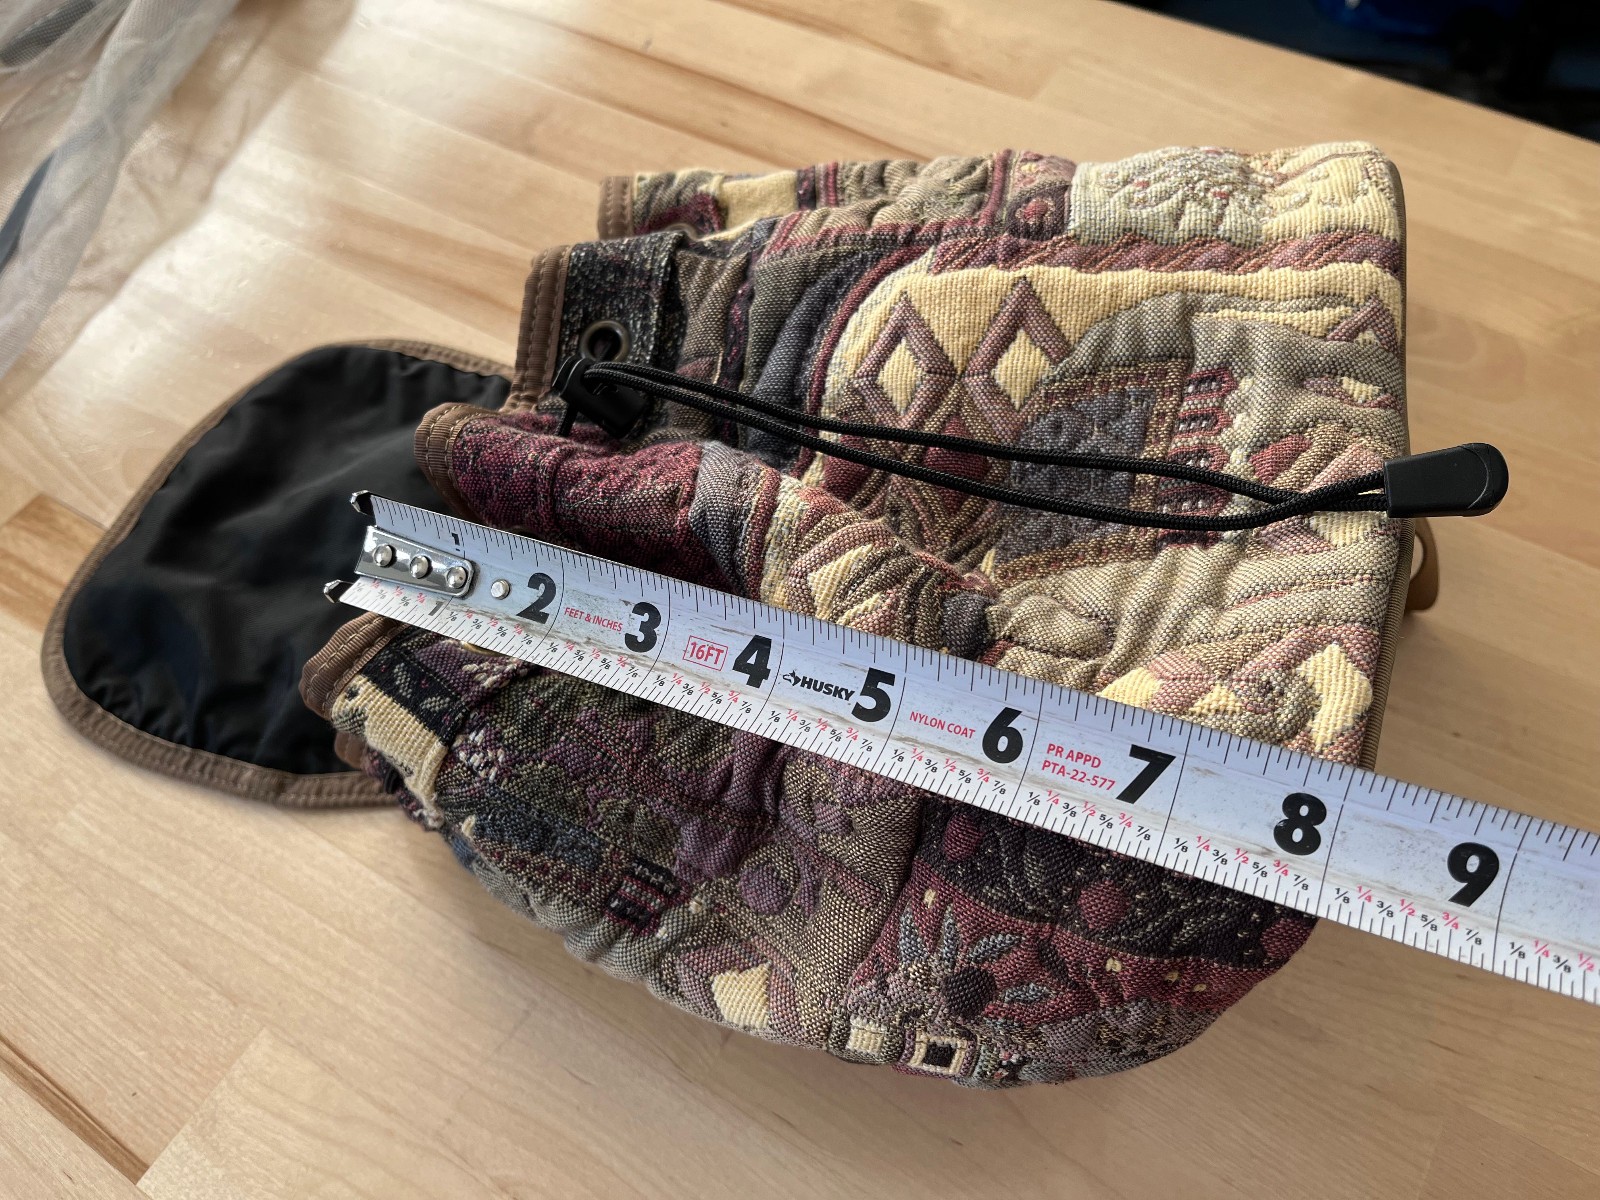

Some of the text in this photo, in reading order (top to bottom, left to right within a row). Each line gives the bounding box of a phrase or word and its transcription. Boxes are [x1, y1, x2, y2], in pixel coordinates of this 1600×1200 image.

[516, 572, 557, 624] 2
[564, 607, 623, 631] FEET & INCHES
[624, 601, 662, 652] 3
[688, 641, 724, 665] 16FT
[732, 635, 772, 689] 4
[655, 673, 752, 713] 1/8 1/4 3/8 1/2 5/8 3/4 7/8
[800, 675, 855, 701] HUSKY
[851, 667, 896, 722] 5
[769, 709, 873, 752] 1/8 1/4 3/8 1/2 5/8 3/4 7/8
[909, 711, 976, 739] NYLON COAT
[982, 707, 1023, 763] 6
[892, 748, 1007, 795] 1/8 1/4 3/8 1/2 5/8 3/4 7/8
[1041, 761, 1116, 791] PTA-22-577
[1046, 743, 1102, 769] PR APPD
[1116, 744, 1176, 804] 7
[1027, 790, 1151, 841] 1/8 1/4 3/8 1/2 5/8 3/4 7/8
[1273, 792, 1328, 856] 8
[1175, 836, 1309, 891] 1/8 1/4 3/8 1/2 5/8 3/4 7/8
[1447, 841, 1499, 908] 9
[1334, 886, 1482, 946] 1/8 1/4 3/8 1/2 5/8 3/4 7/8
[1509, 941, 1595, 973] 1/8 1/4 3/8 1/2
